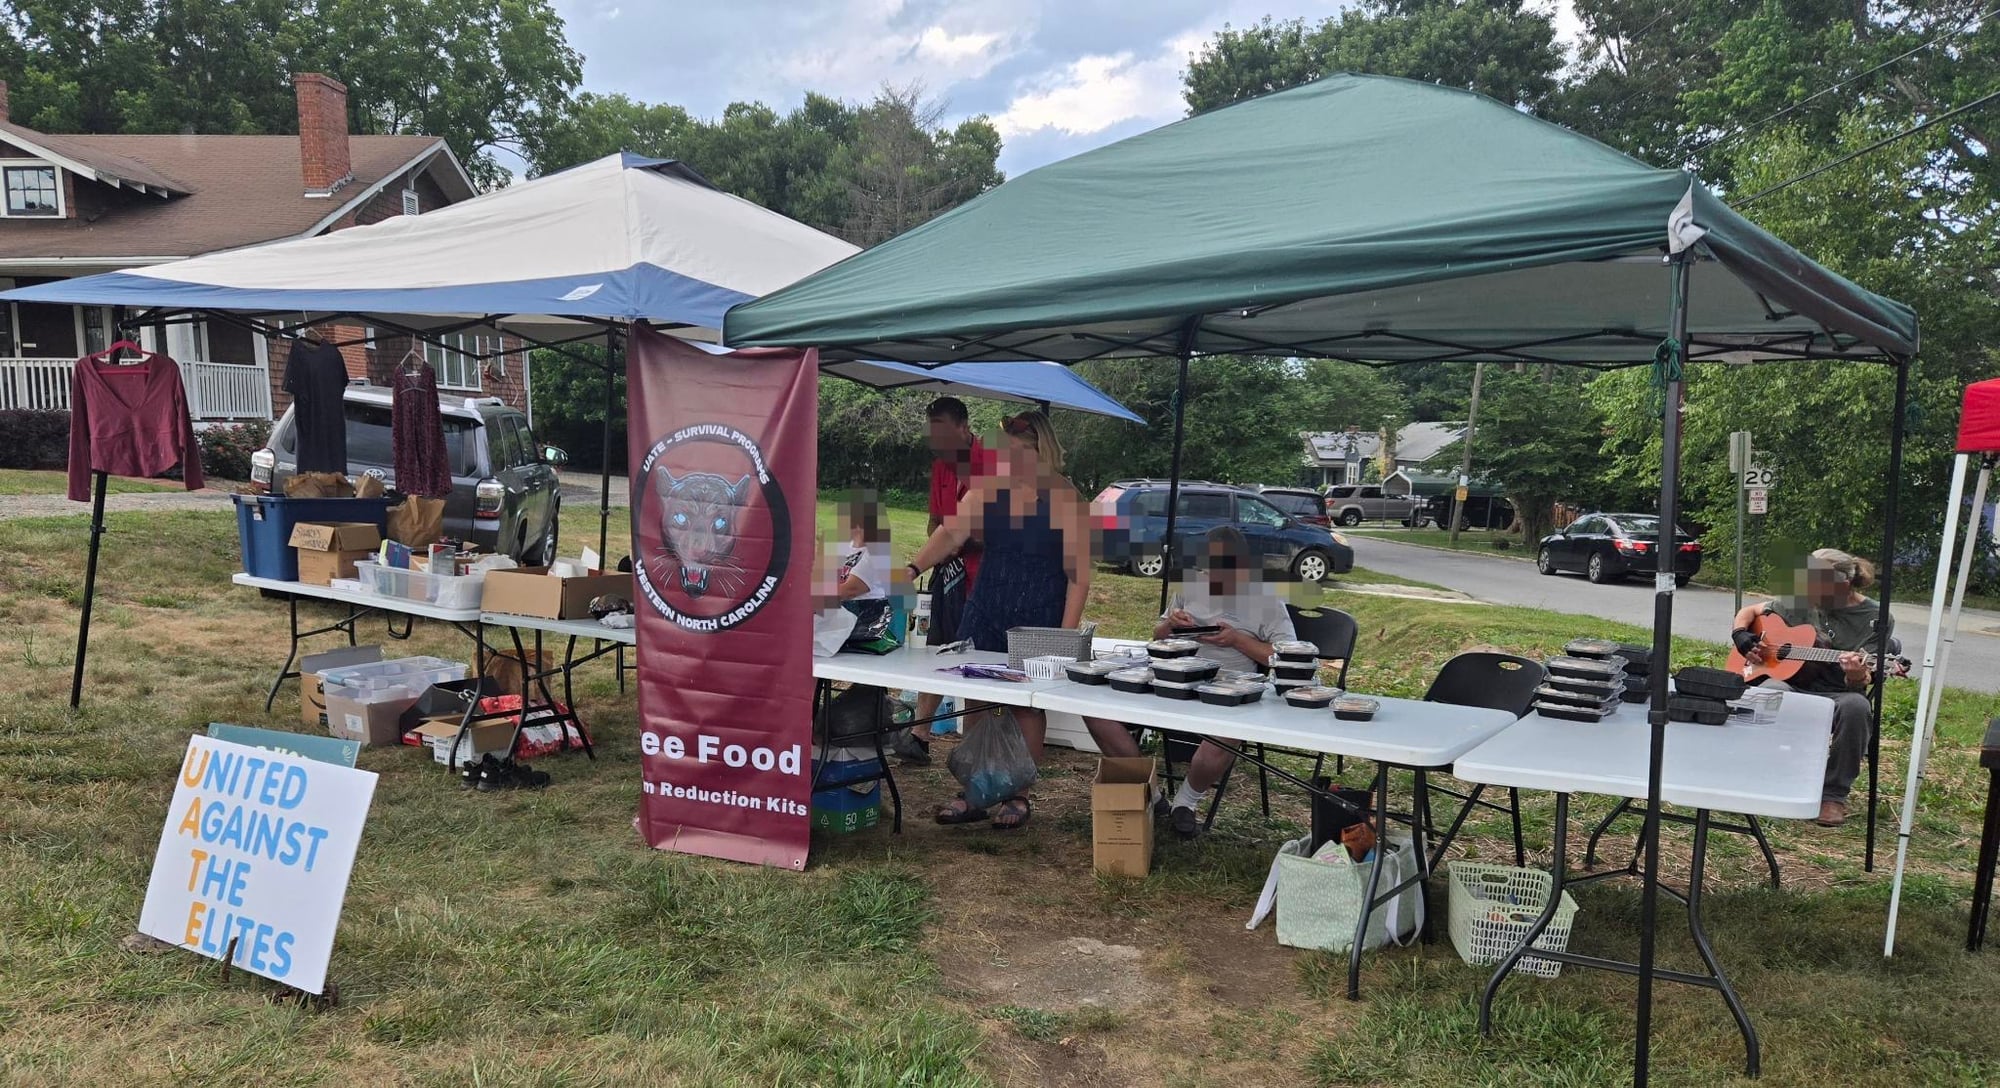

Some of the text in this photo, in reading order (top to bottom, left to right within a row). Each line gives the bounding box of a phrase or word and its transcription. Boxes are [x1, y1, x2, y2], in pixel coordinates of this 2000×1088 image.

[643, 441, 667, 473] UATE
[674, 424, 730, 443] SURVIVAL
[730, 430, 770, 485] PROGRAMS
[1745, 471, 1773, 485] 20
[635, 559, 778, 631] WESTERN NORTH CAROLINA
[183, 746, 308, 810] UNITED
[698, 734, 801, 776] Food
[660, 781, 762, 810] Reduction
[766, 796, 808, 817] Kits
[845, 812, 858, 826] 50
[178, 796, 329, 873] AGAINST
[188, 848, 251, 907] THE
[185, 901, 296, 978] ELITES
